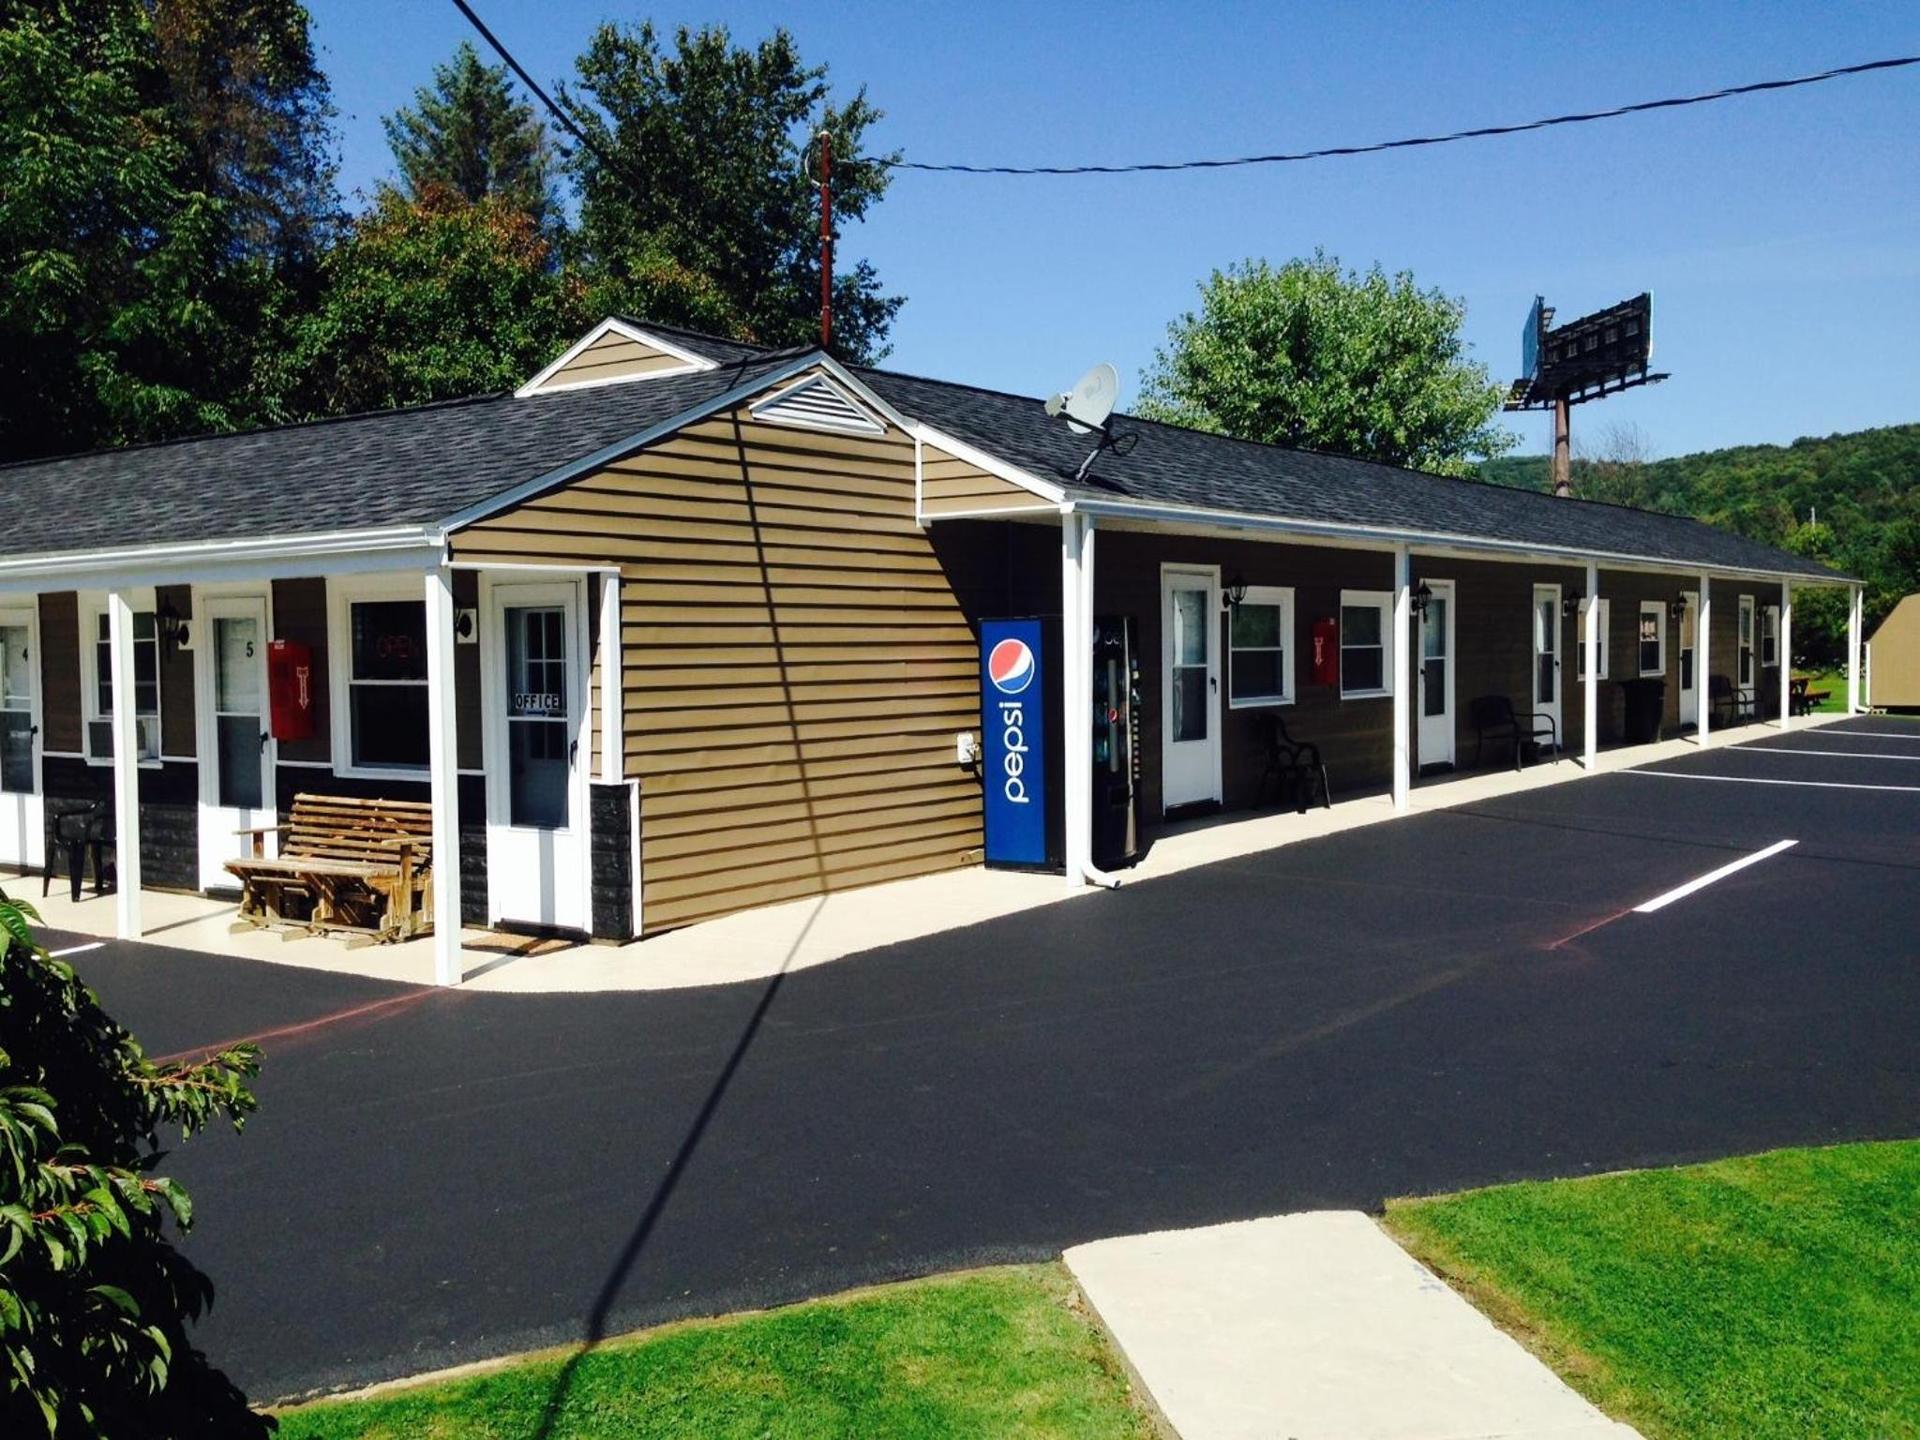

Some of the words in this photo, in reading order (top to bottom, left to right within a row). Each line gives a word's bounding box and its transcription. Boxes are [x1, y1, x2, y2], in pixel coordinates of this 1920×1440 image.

[246, 641, 254, 658] 5
[516, 694, 559, 709] OFFICE
[999, 702, 1029, 803] pepsi
